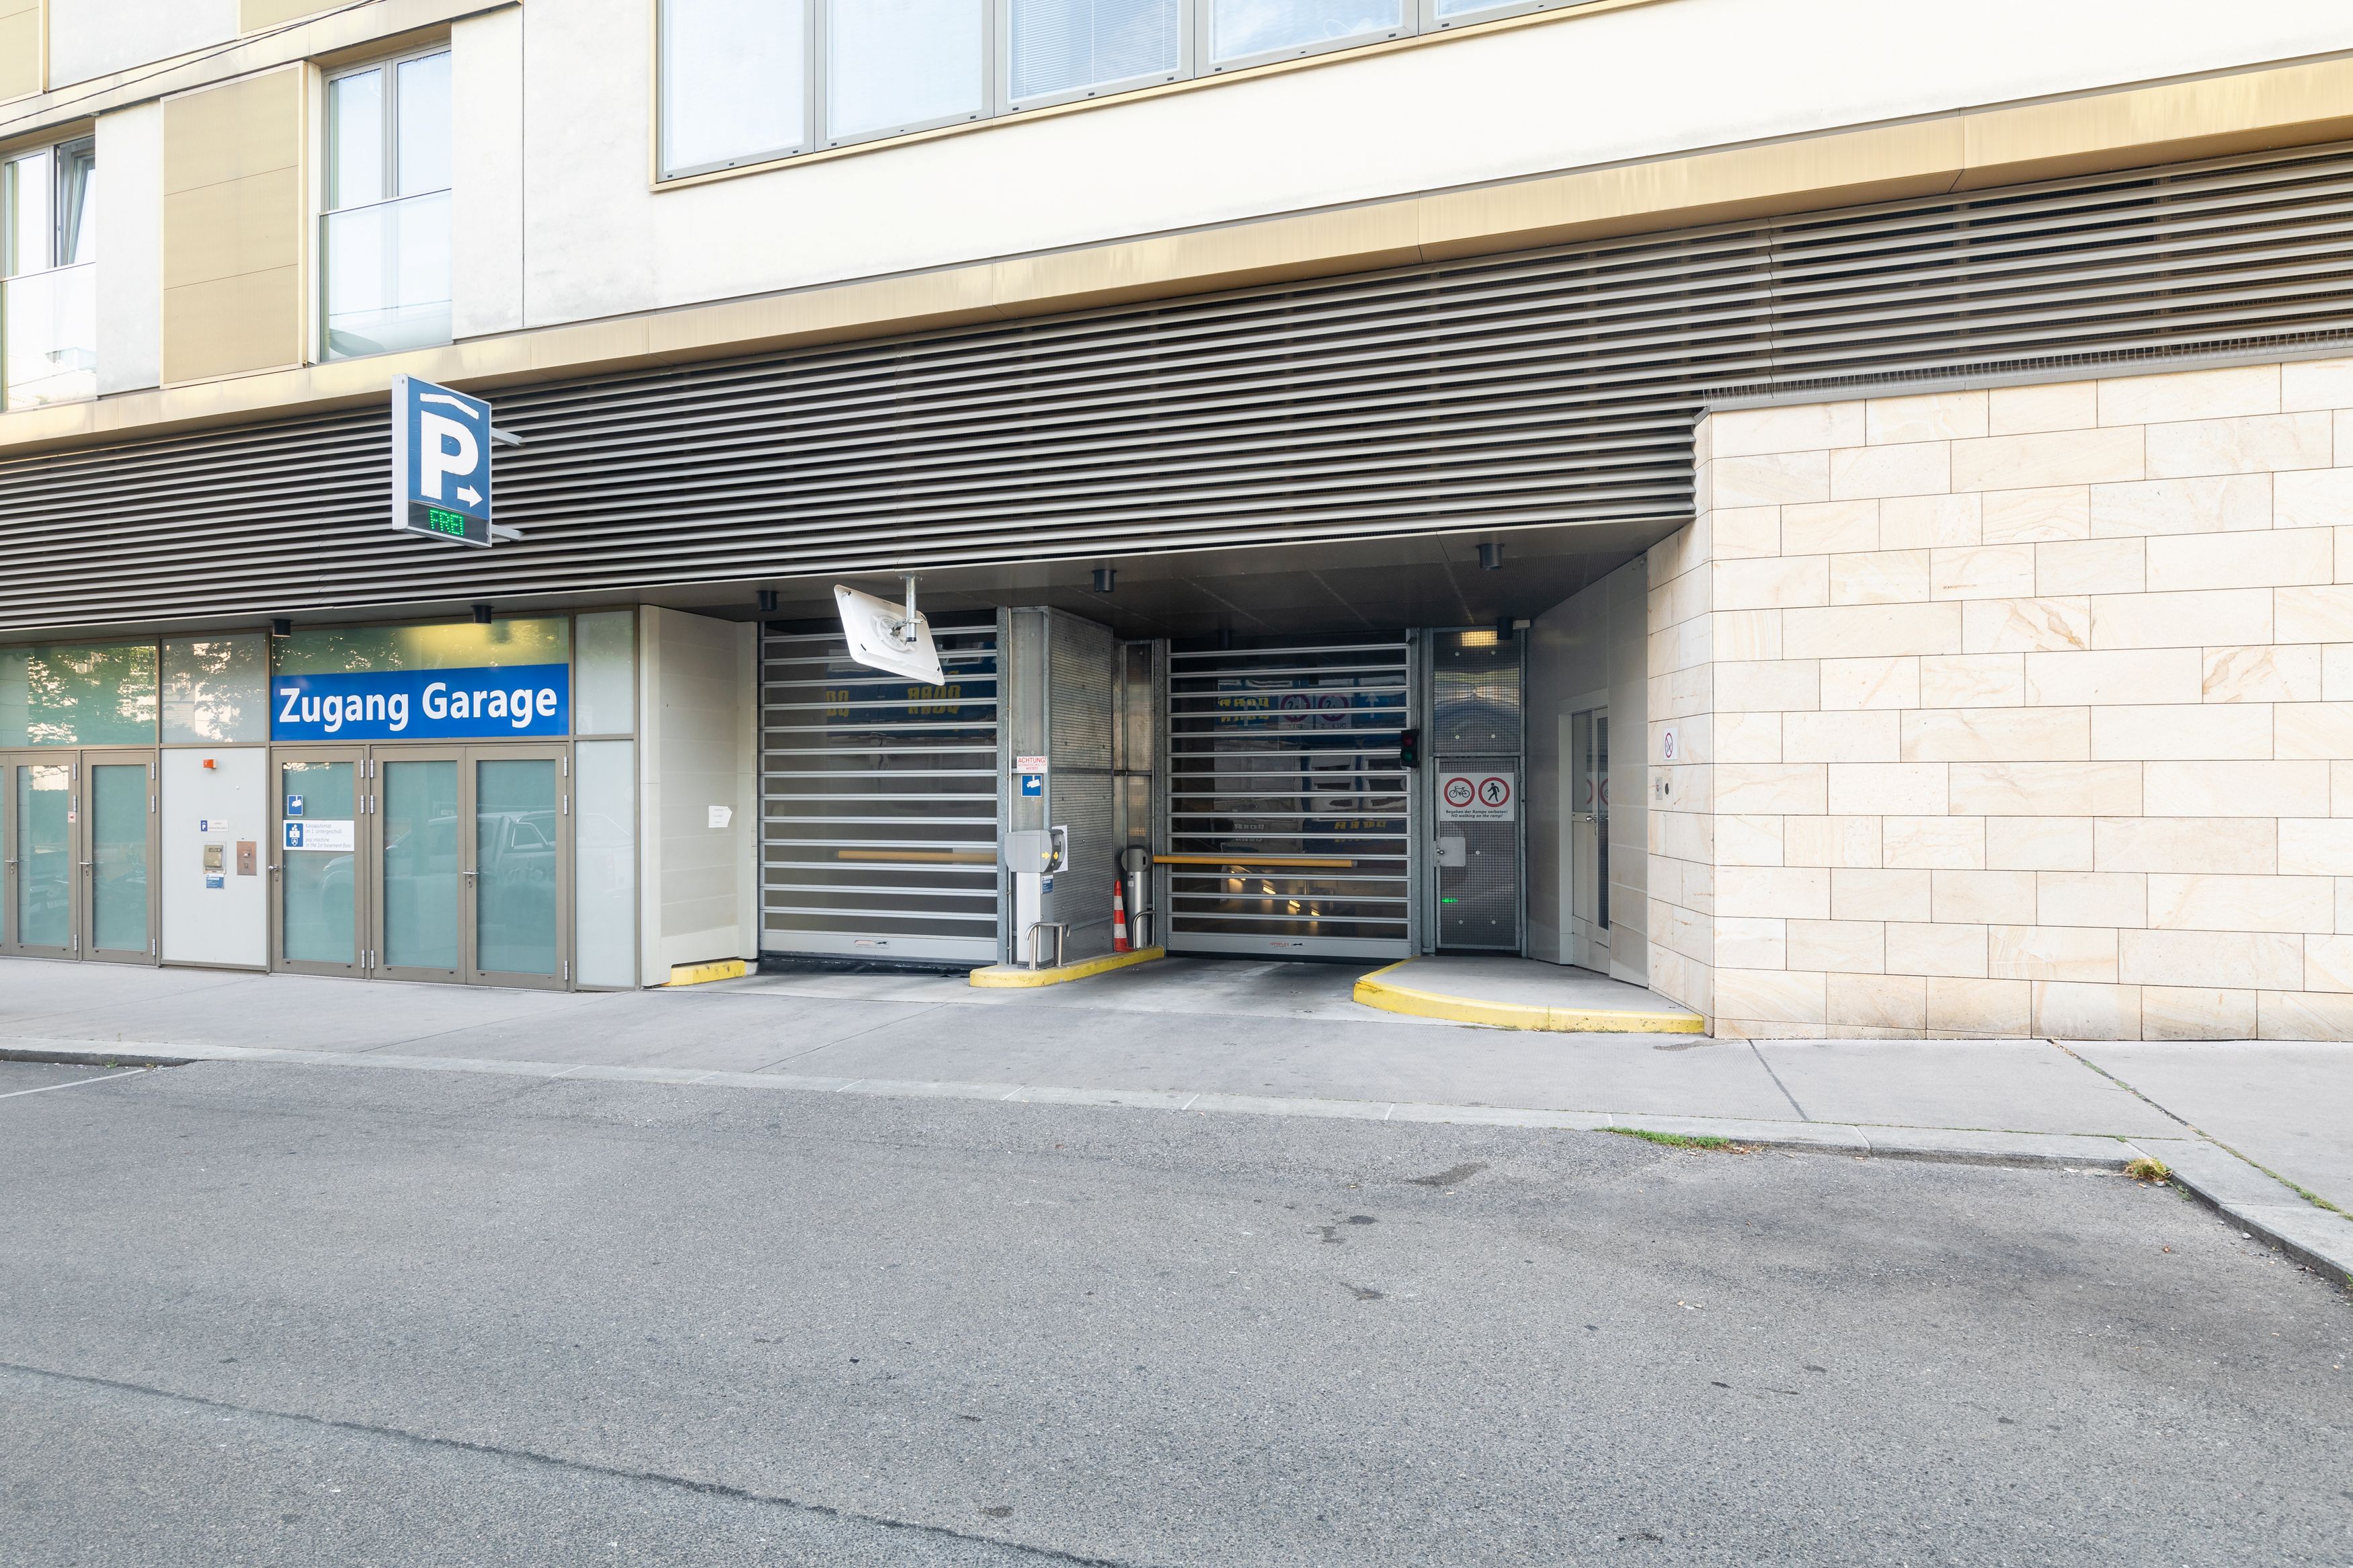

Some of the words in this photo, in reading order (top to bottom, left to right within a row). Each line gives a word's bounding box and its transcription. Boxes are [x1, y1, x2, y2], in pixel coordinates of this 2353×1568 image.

[421, 410, 479, 500] P
[430, 509, 464, 536] FREI
[279, 688, 409, 732] Zugang
[422, 682, 557, 728] Garage
